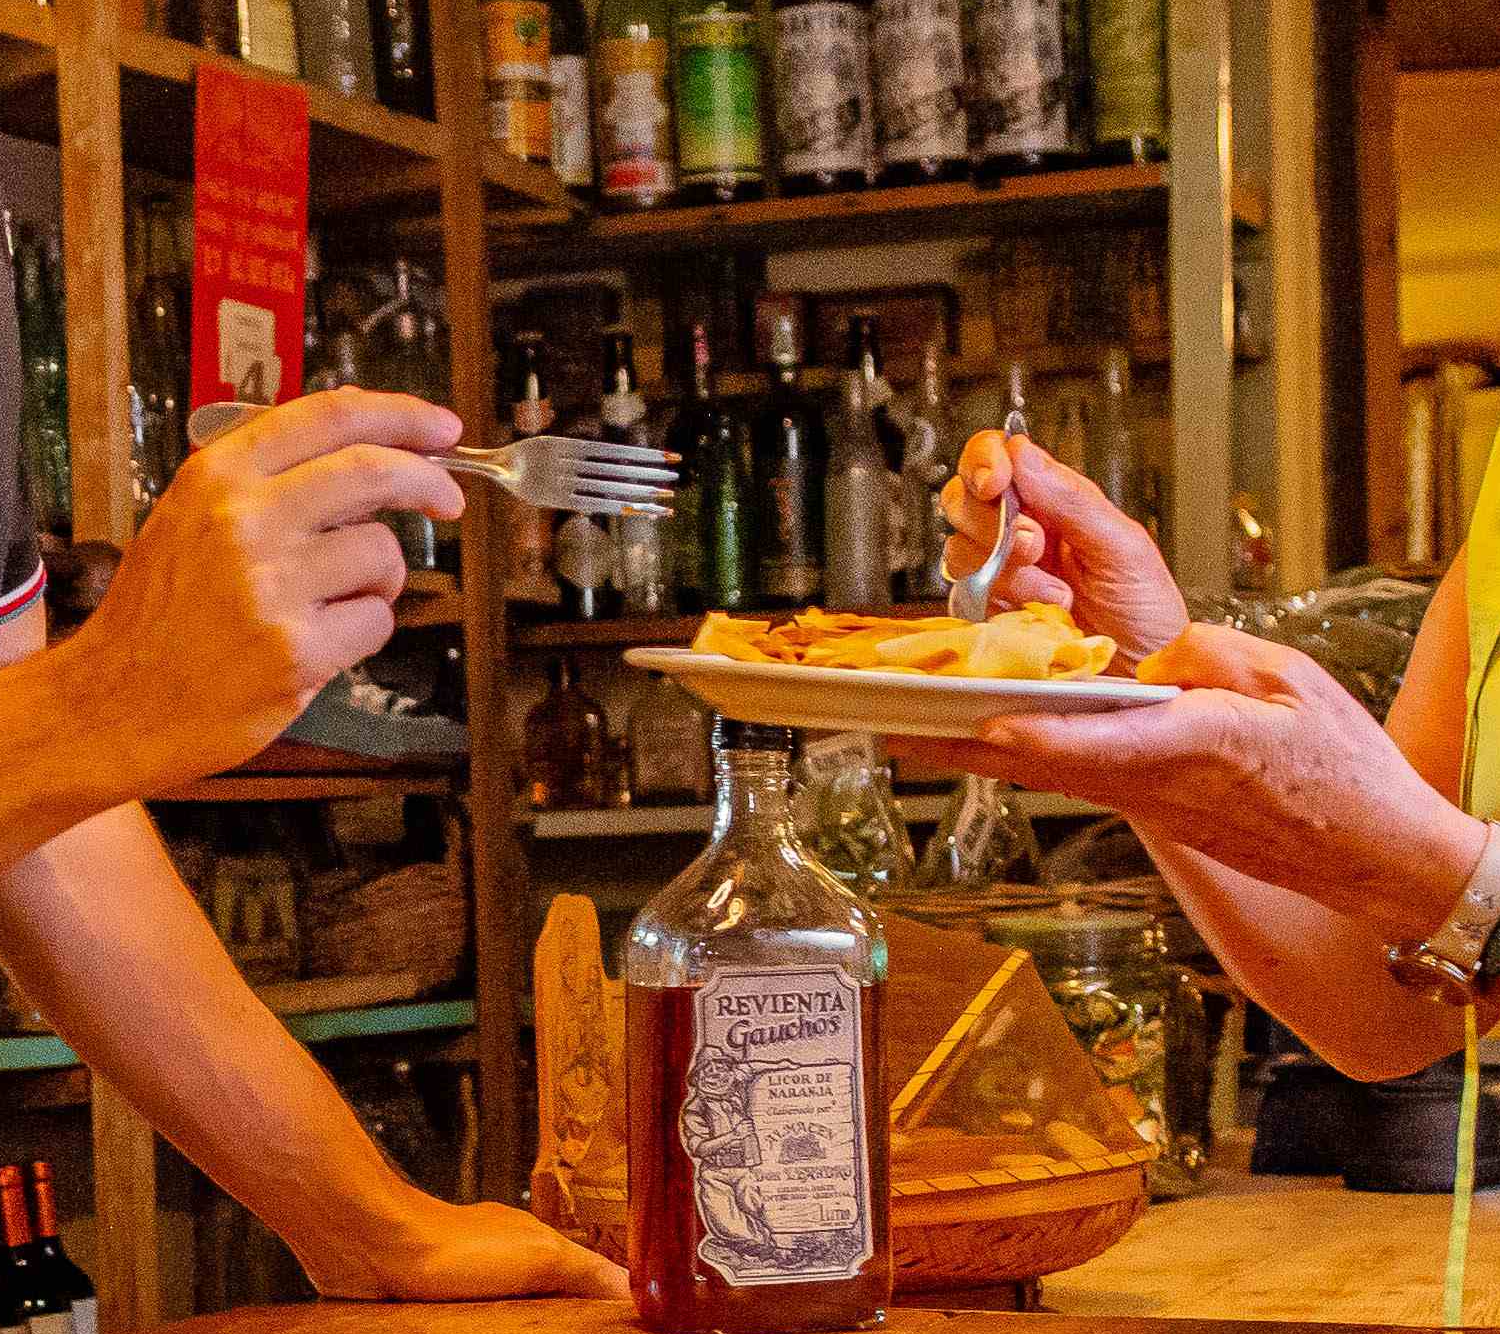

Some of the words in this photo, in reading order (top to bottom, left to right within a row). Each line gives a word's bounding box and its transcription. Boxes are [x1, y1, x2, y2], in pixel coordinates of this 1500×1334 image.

[716, 991, 846, 1017] REVIENTA
[726, 1016, 841, 1059] Gauchos
[768, 1074, 811, 1085] LICOR
[816, 1072, 832, 1084] DE
[768, 1086, 834, 1099] NARANJA
